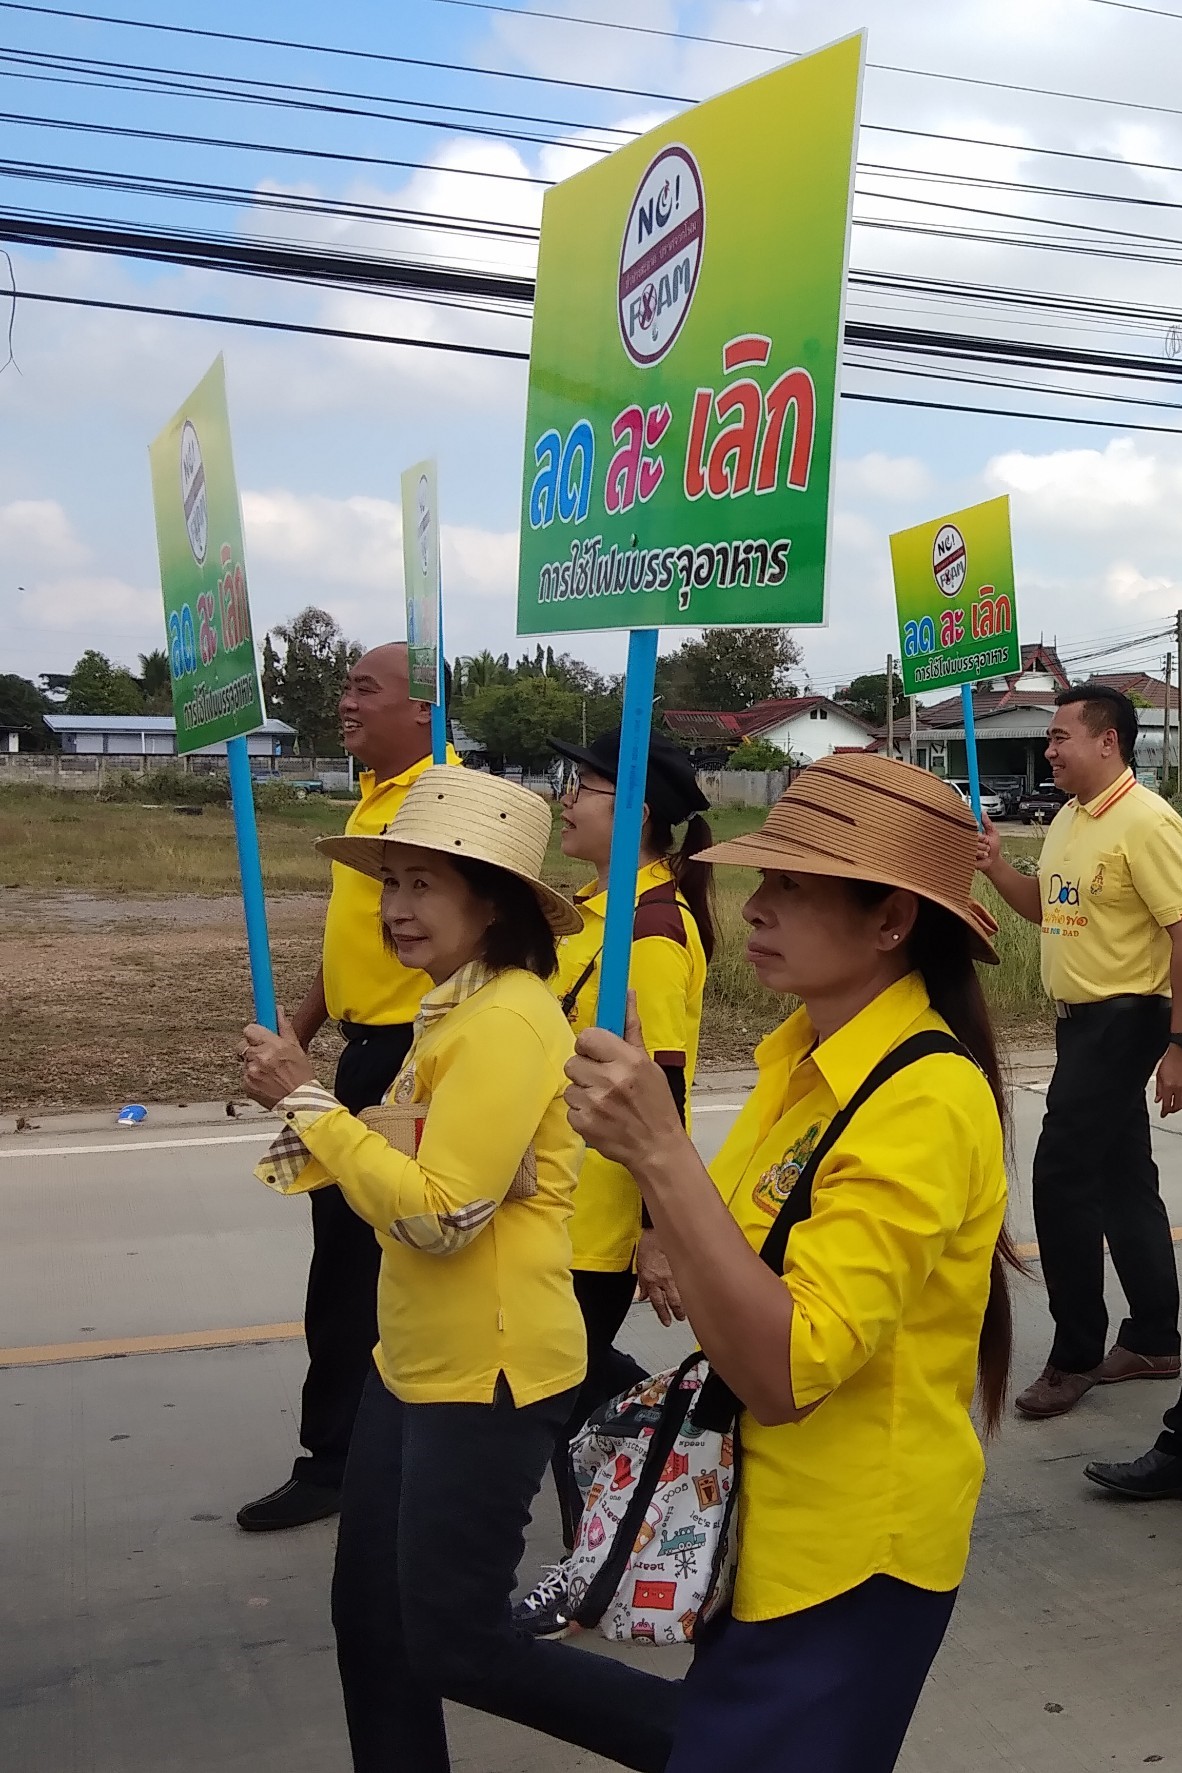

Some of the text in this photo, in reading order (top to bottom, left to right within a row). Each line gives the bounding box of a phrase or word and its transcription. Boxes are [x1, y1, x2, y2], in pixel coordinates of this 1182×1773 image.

[637, 174, 681, 245] NO!
[529, 333, 817, 530] ลด ละ เลิก
[538, 535, 791, 610] การใช้โฟมบรรจุอาหาร
[168, 602, 196, 681] ลด
[218, 543, 250, 653] เลิก
[904, 584, 1012, 658] ลด ละ เลิก
[914, 645, 1009, 684] การใช้โฟมบรรจุอาหาร
[1048, 874, 1080, 906] Dad
[1062, 929, 1080, 937] DAD
[661, 1482, 689, 1503] good
[689, 1509, 711, 1528] let's
